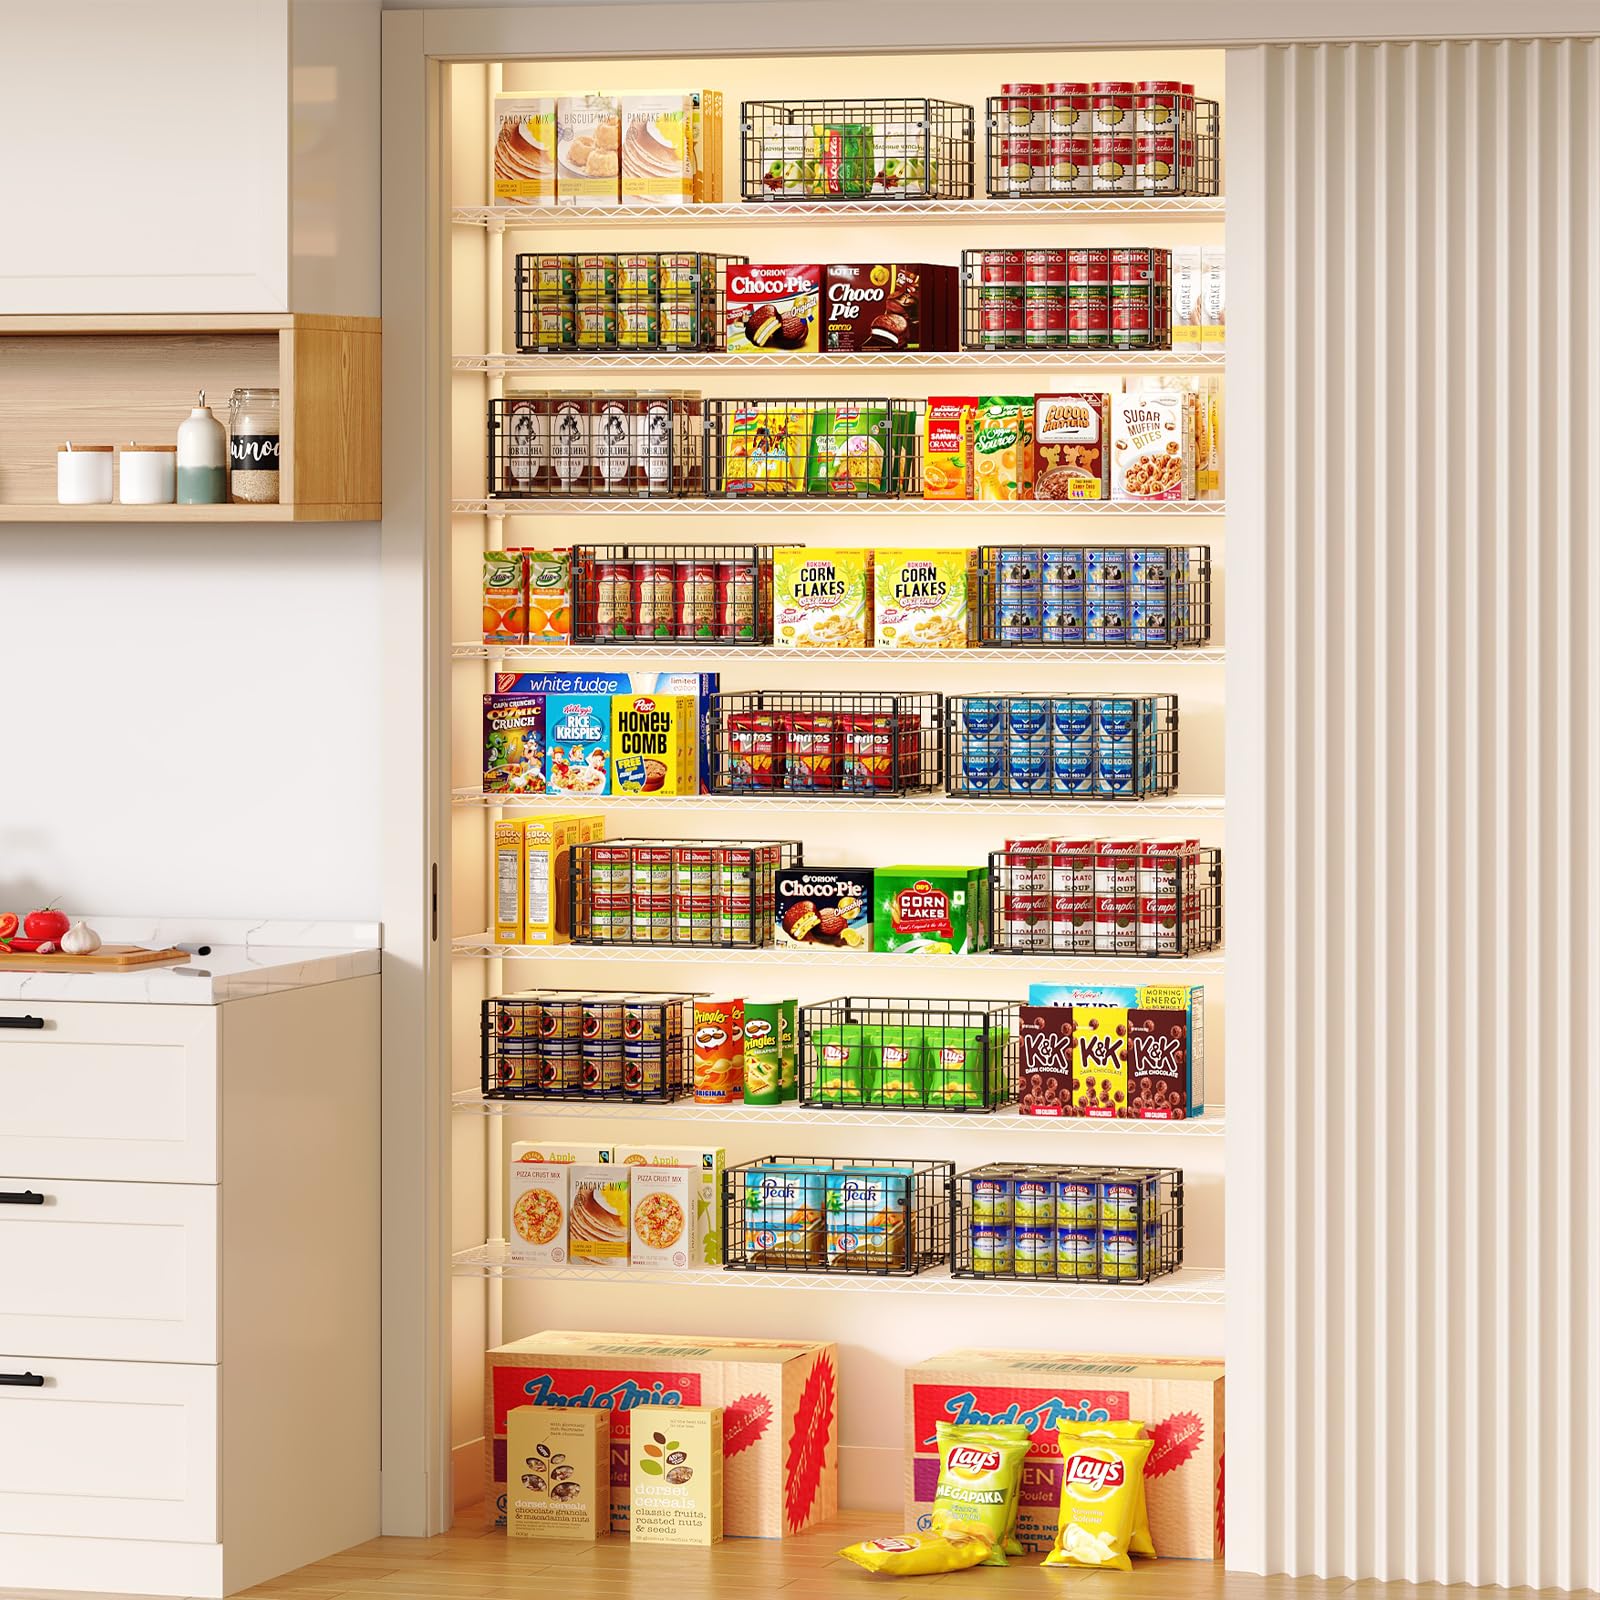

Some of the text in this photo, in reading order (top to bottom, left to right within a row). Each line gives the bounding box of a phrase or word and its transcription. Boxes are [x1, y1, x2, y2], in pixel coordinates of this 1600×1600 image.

[499, 114, 549, 125] PANCAKE MIX
[564, 113, 611, 124] BISCUIT MIX
[627, 113, 678, 123] PANCAKE MIX
[828, 283, 884, 301] Choco
[1182, 265, 1192, 321] PANCAKE MIX
[1211, 265, 1221, 321] PANCAKE MIX
[791, 297, 817, 317] Original
[829, 302, 860, 321] Pie
[1123, 409, 1161, 423] SUGAR
[1127, 422, 1160, 436] MUFFIN
[975, 434, 1016, 451] Source
[1132, 431, 1162, 449] BITES
[489, 566, 515, 587] 5
[536, 566, 562, 587] 5
[801, 567, 835, 582] CORN
[902, 567, 936, 582] CORN
[795, 581, 845, 598] FLAKES
[896, 581, 946, 598] FLAKES
[530, 676, 618, 692] white fudge
[509, 699, 535, 707] CRUNCH'S
[562, 705, 593, 714] Kellogg's
[635, 699, 655, 711] Post
[487, 707, 541, 720] COZMIC
[492, 717, 535, 730] CRUNCH
[567, 715, 590, 727] RICE
[556, 727, 602, 740] KRISPIES
[622, 733, 667, 754] COMB
[618, 756, 641, 769] FREE
[834, 899, 863, 916] Chocochip
[901, 896, 945, 907] CORN
[901, 908, 945, 918] FLAKES
[1145, 997, 1182, 1005] ENERGY
[1024, 1033, 1071, 1072] K&K
[1080, 1036, 1123, 1069] K&K
[1134, 1036, 1180, 1073] K&K
[1094, 1068, 1122, 1076] CHOCOLATE
[1149, 1070, 1178, 1078] CHOCOLATE
[550, 1153, 575, 1162] Apple
[575, 1181, 621, 1191] PANCAKE MIX
[762, 1179, 795, 1199] Peak
[844, 1182, 876, 1202] Peak
[1174, 1422, 1197, 1445] taste
[950, 1448, 999, 1474] Lay's
[1067, 1457, 1121, 1491] Lay's
[635, 1485, 688, 1497] dorset
[936, 1485, 1004, 1504] MEGAPAKA
[515, 1500, 586, 1510] dorset cereals
[635, 1498, 696, 1509] cereals
[515, 1507, 588, 1517] chocolate granola
[524, 1515, 575, 1523] macadamia
[635, 1509, 673, 1517] classic
[636, 1517, 703, 1527] roasted nuts
[636, 1525, 676, 1534] & seeds
